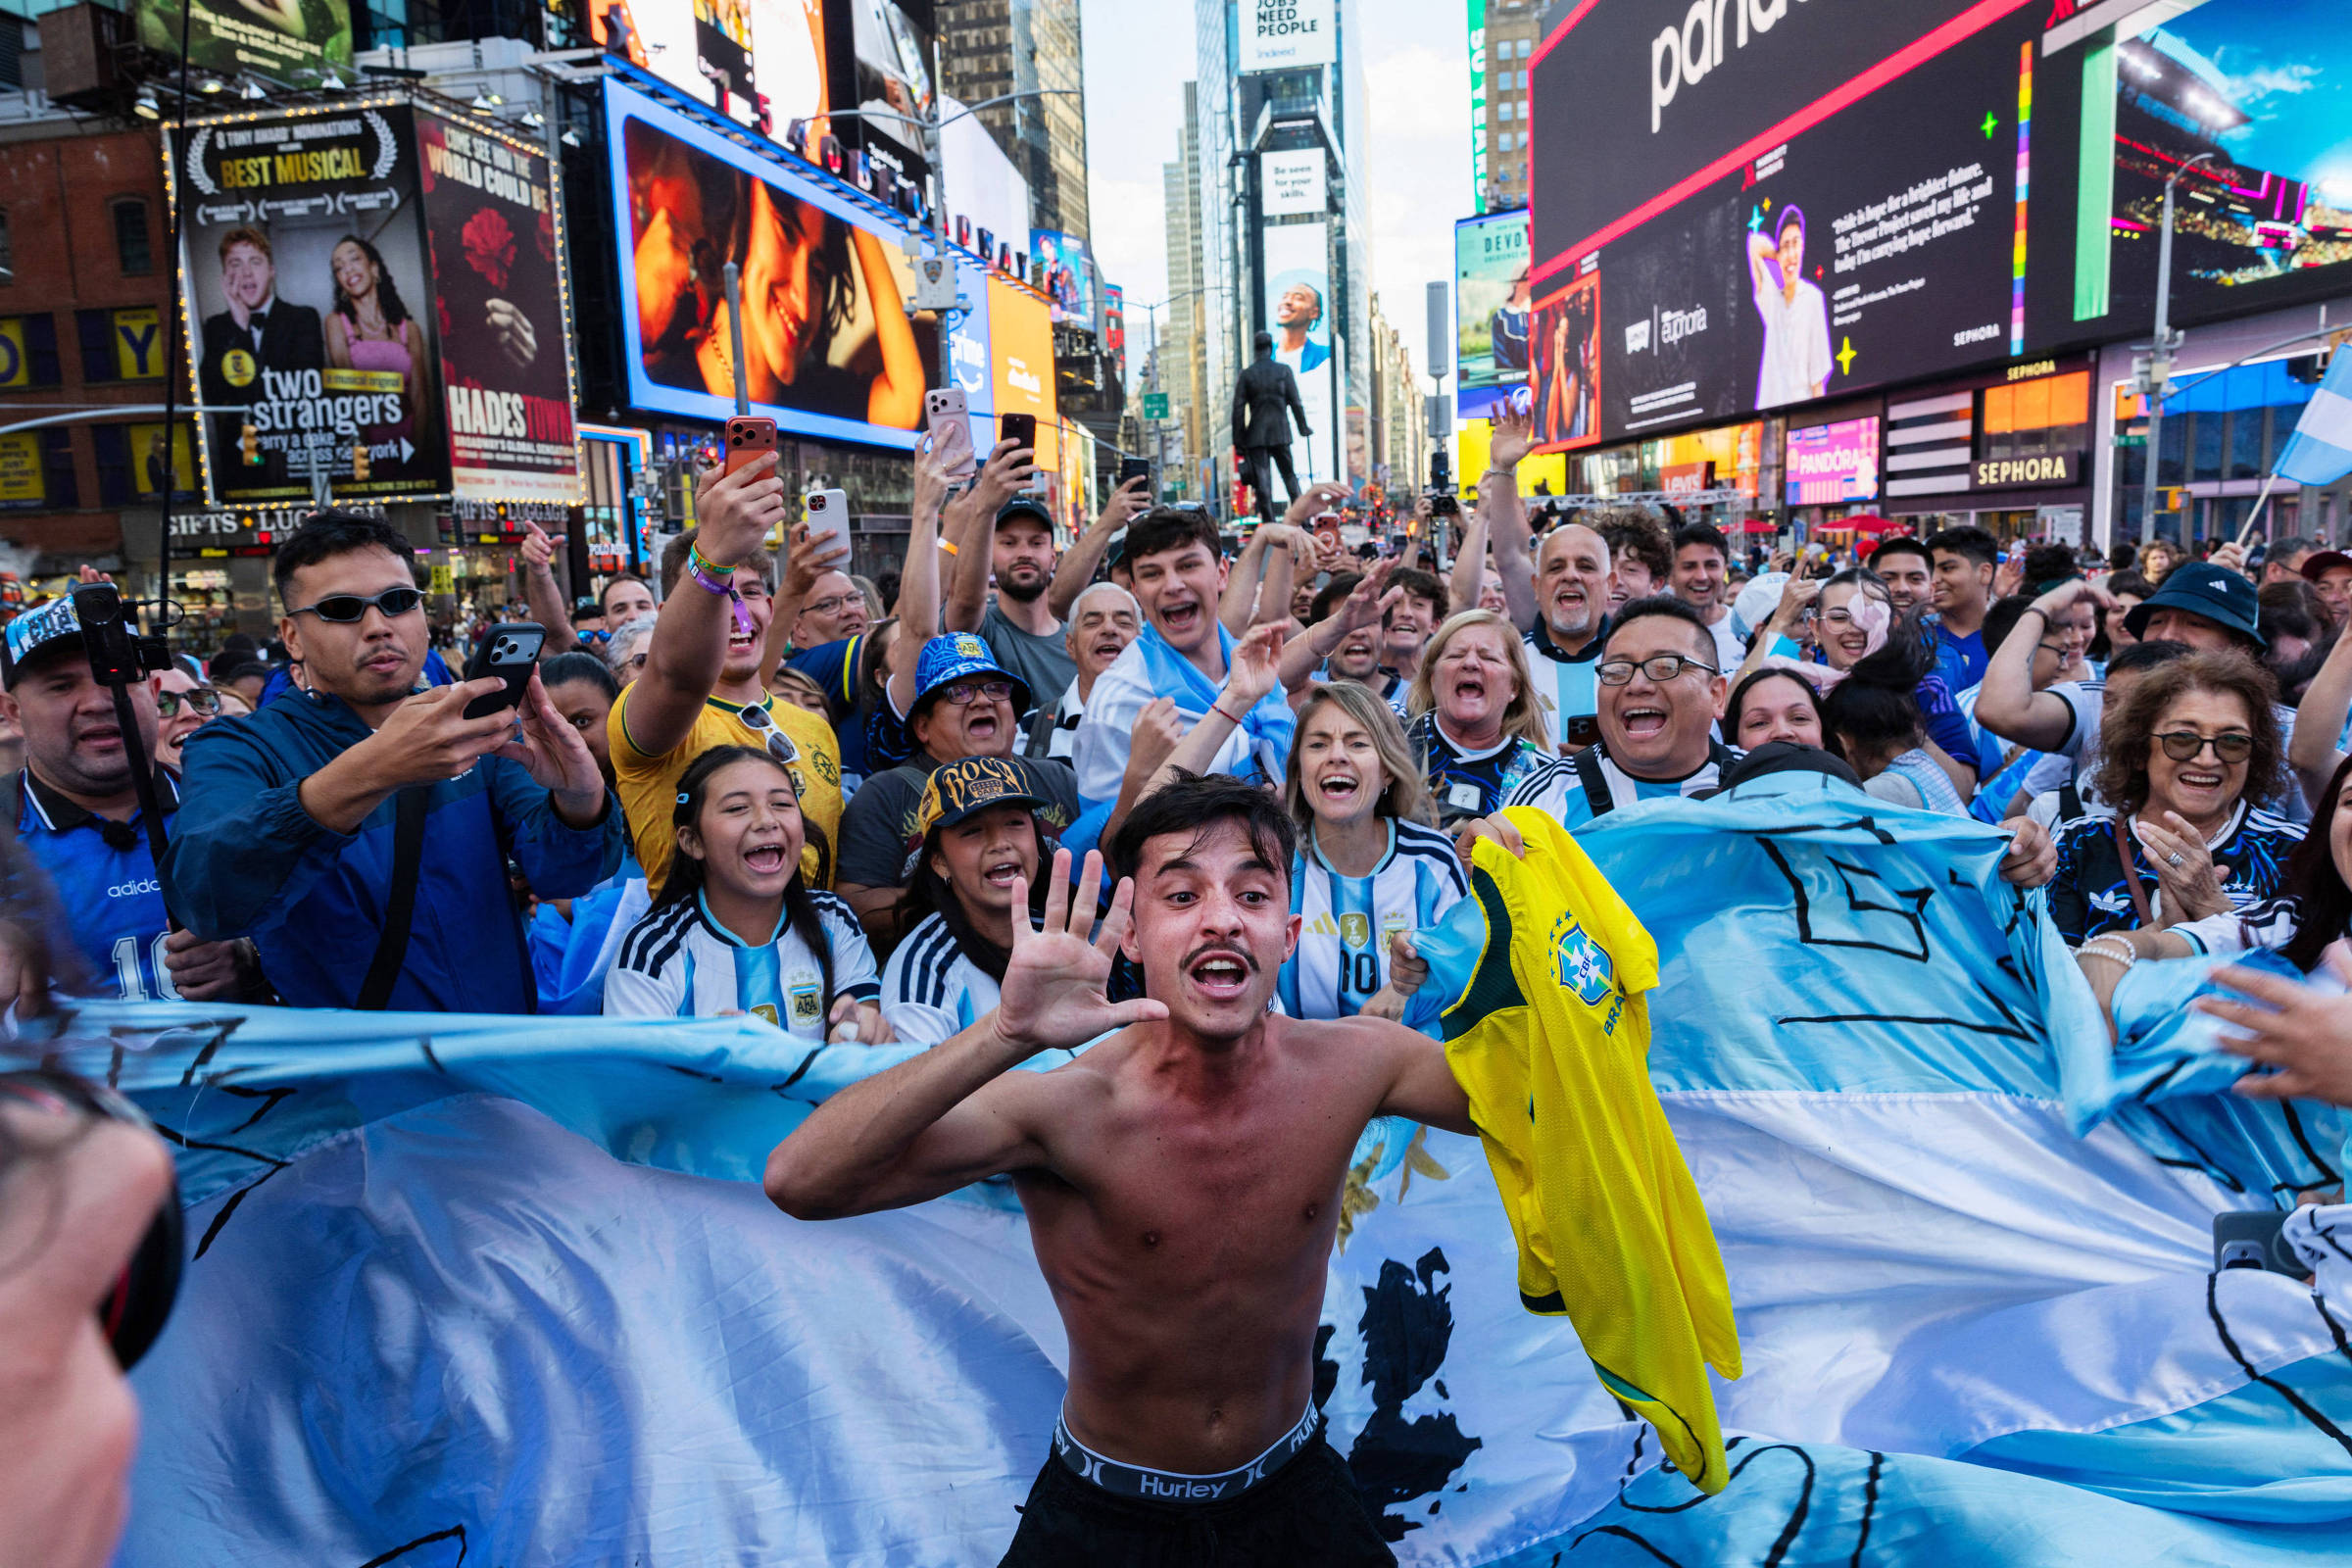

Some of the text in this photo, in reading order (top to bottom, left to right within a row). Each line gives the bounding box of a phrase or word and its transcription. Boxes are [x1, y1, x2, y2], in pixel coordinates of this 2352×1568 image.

[1257, 8, 1297, 23] NEED
[1257, 20, 1317, 37] PEOPLE
[471, 137, 492, 165] SEE
[220, 148, 367, 188] BEST MUSICAL
[426, 142, 483, 188] WORLD
[483, 166, 531, 207] COULD
[1954, 323, 2000, 346] SEPHORA
[262, 366, 322, 400] two
[2007, 360, 2056, 380] SEPHORA
[253, 394, 403, 436] strangers
[257, 434, 288, 453] arry
[1800, 447, 1860, 475] PANDORA
[1978, 456, 2066, 485] SEPHORA
[507, 501, 569, 521] LUGGAGE
[942, 758, 1023, 812] BOCA
[1340, 949, 1377, 995] 10
[1579, 953, 1592, 979] CBF
[797, 994, 817, 1015] AFA
[1140, 1474, 1229, 1498] Hurley
